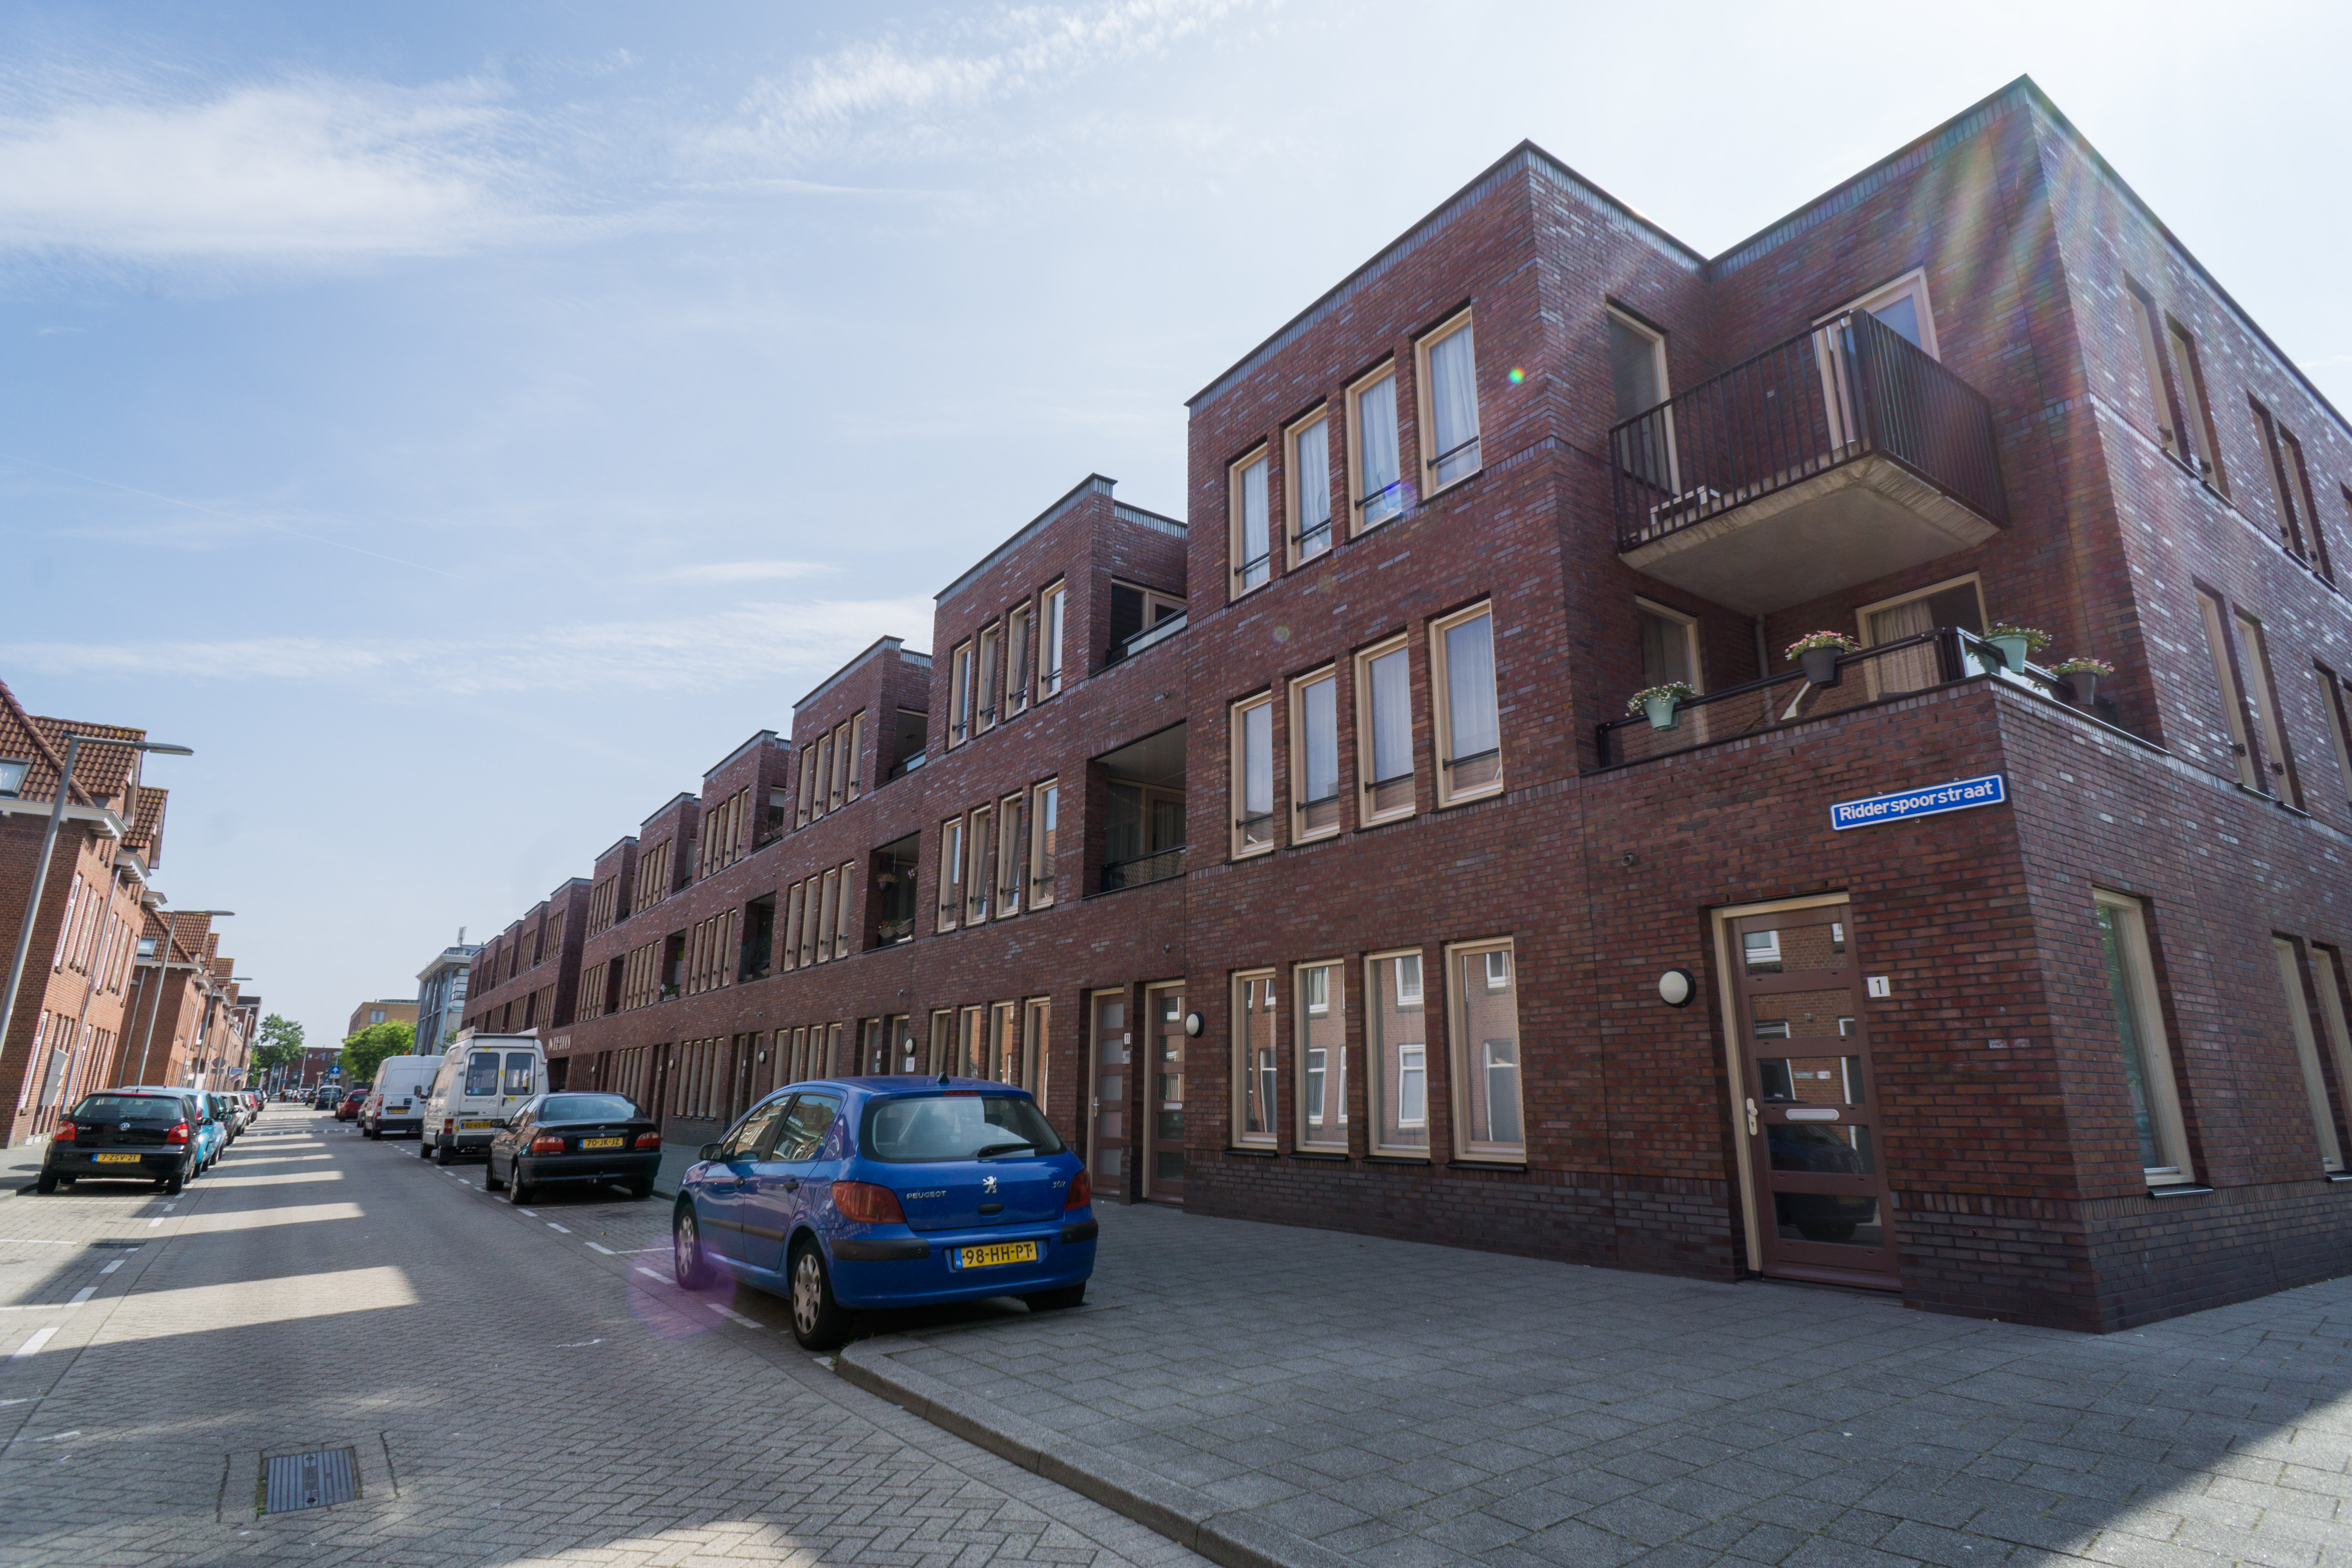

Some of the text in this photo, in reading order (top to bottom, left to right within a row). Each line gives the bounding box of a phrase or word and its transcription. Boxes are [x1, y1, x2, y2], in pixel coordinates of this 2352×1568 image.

[1839, 780, 1993, 821] Ridderspoorstraat
[1876, 979, 1882, 994] 1
[1125, 1034, 1129, 1043] 11
[907, 1191, 946, 1200] PEUGEOT
[965, 1244, 1031, 1264] 98-HH-PT
